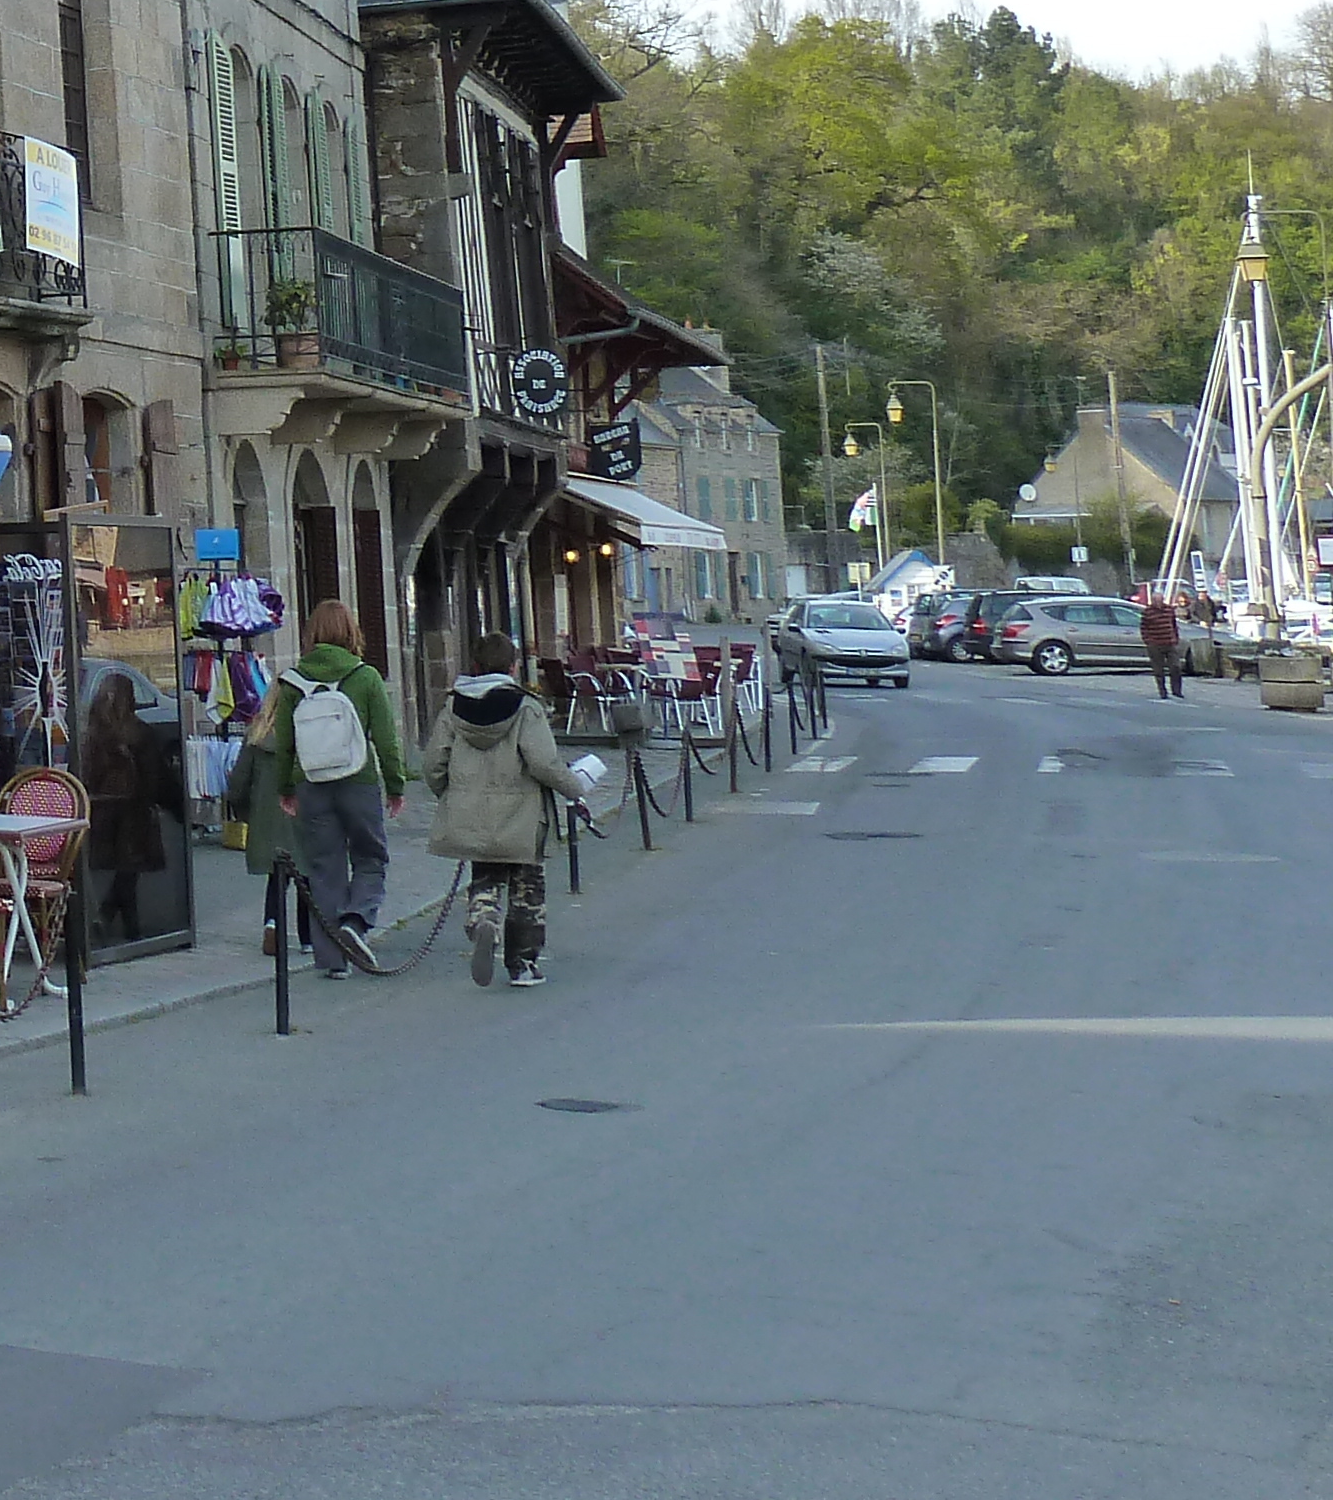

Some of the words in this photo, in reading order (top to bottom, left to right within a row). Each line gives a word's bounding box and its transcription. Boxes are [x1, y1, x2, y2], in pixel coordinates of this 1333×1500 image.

[36, 147, 45, 165] A
[28, 225, 40, 239] 02
[514, 350, 565, 379] ASSOCIATION
[532, 380, 547, 389] DE
